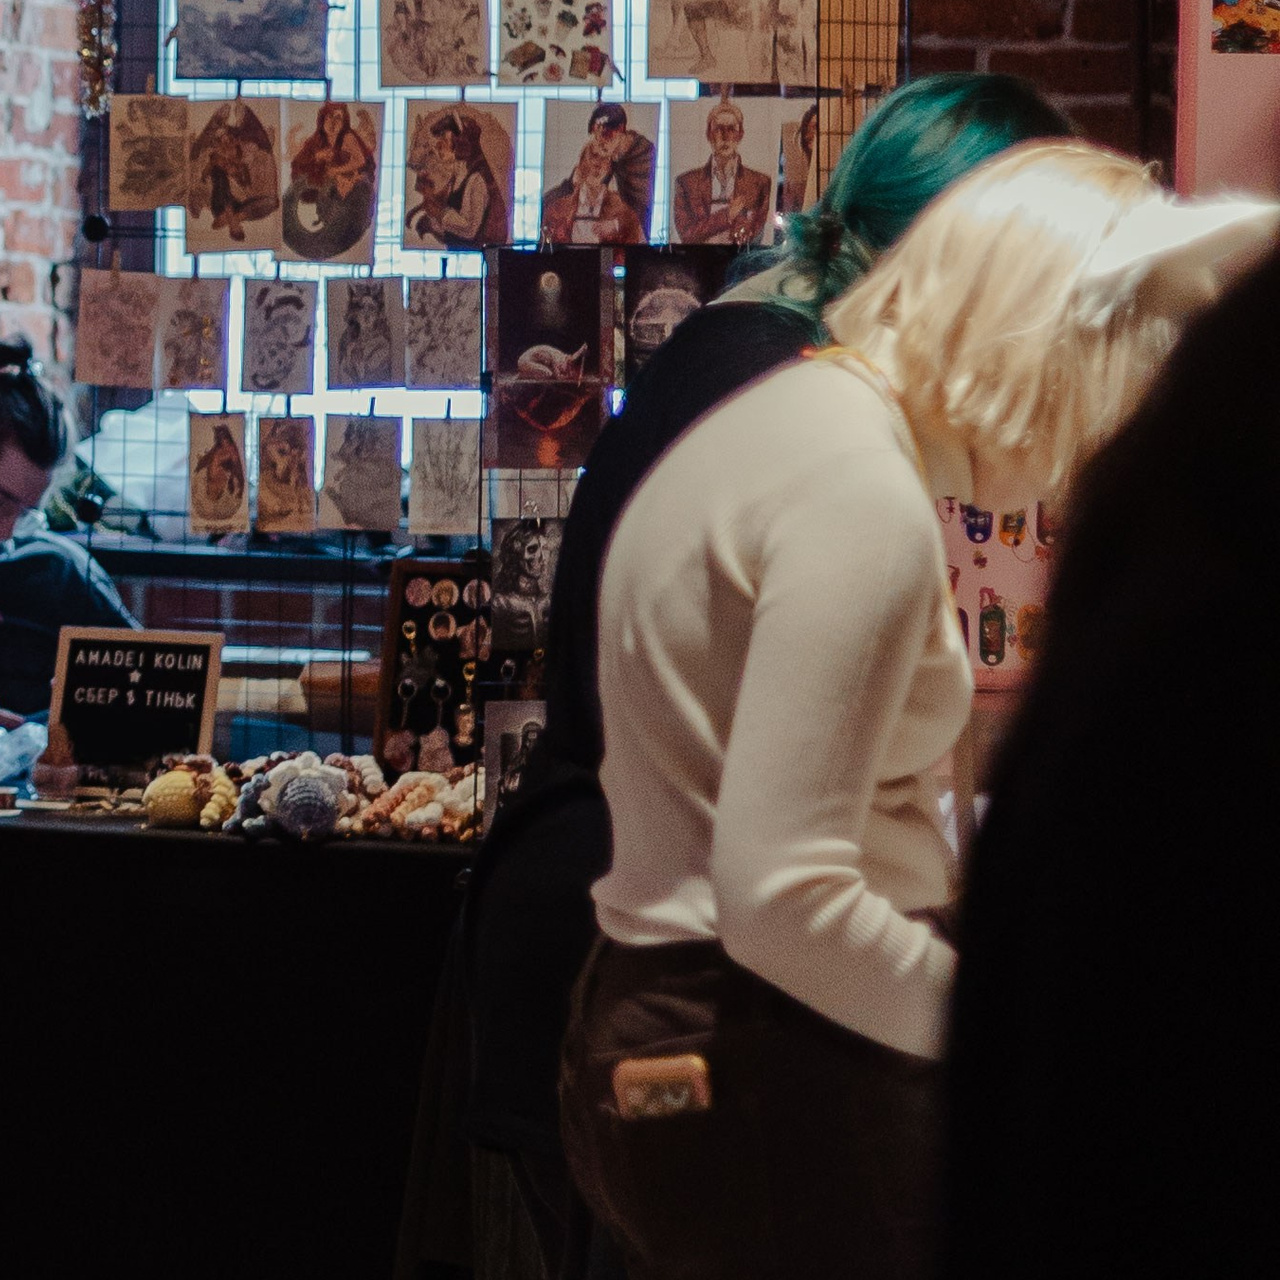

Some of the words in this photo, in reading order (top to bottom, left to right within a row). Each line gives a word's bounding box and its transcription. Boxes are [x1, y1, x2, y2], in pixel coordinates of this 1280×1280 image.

[75, 649, 145, 667] AMADEI
[153, 653, 204, 670] KOLIN
[74, 687, 119, 705] СБЕР
